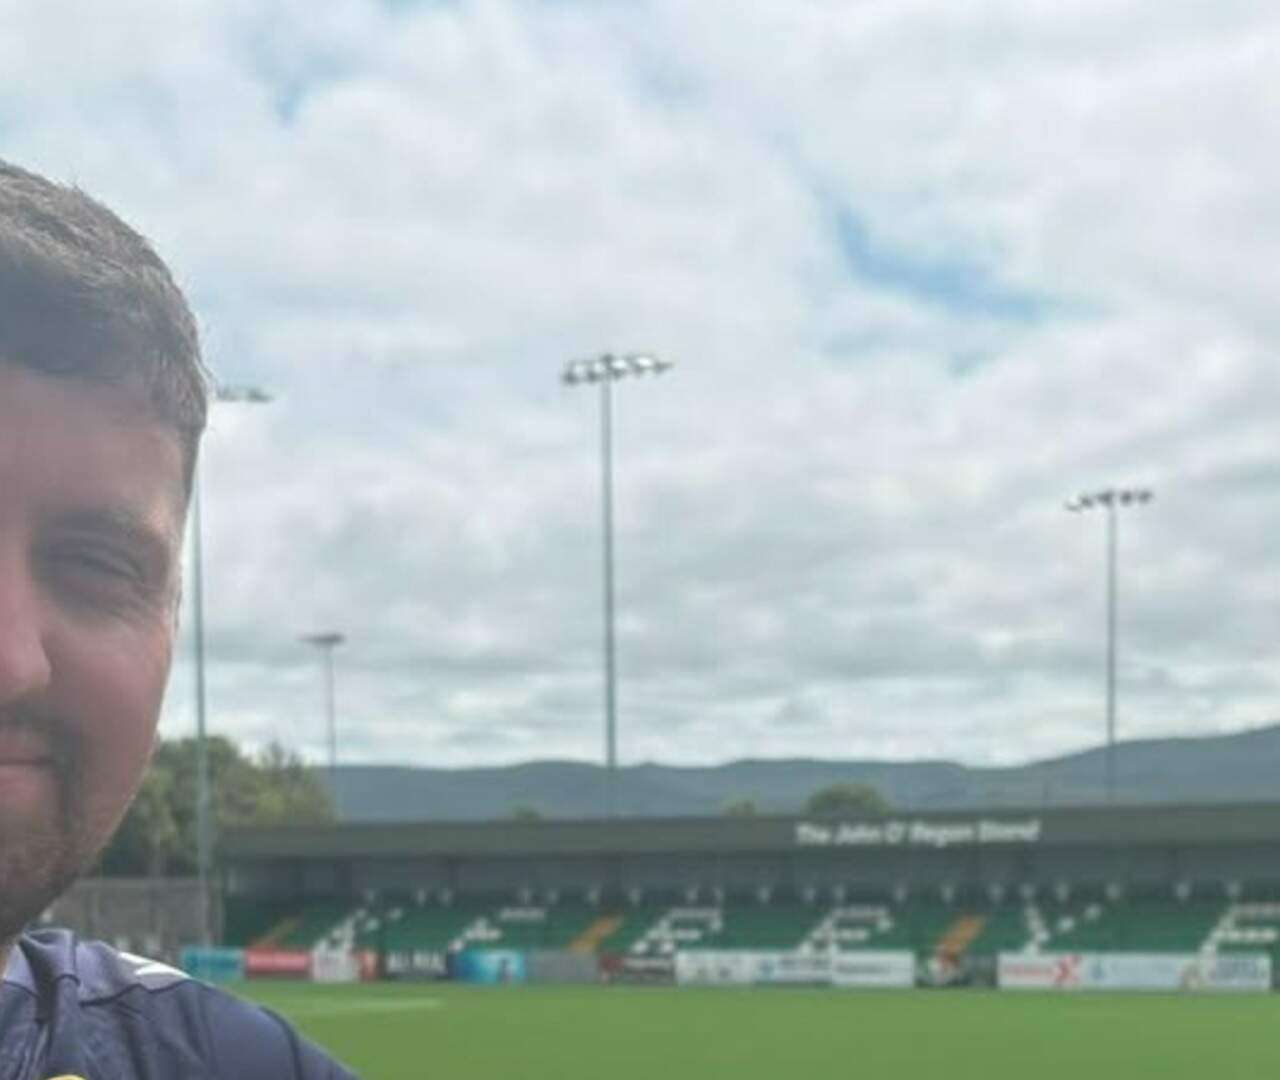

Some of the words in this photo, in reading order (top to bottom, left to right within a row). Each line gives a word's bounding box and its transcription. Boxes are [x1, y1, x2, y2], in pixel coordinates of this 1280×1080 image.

[796, 822, 830, 845] The
[834, 821, 882, 846] John
[909, 820, 974, 848] Regan
[978, 819, 1041, 843] Stand
